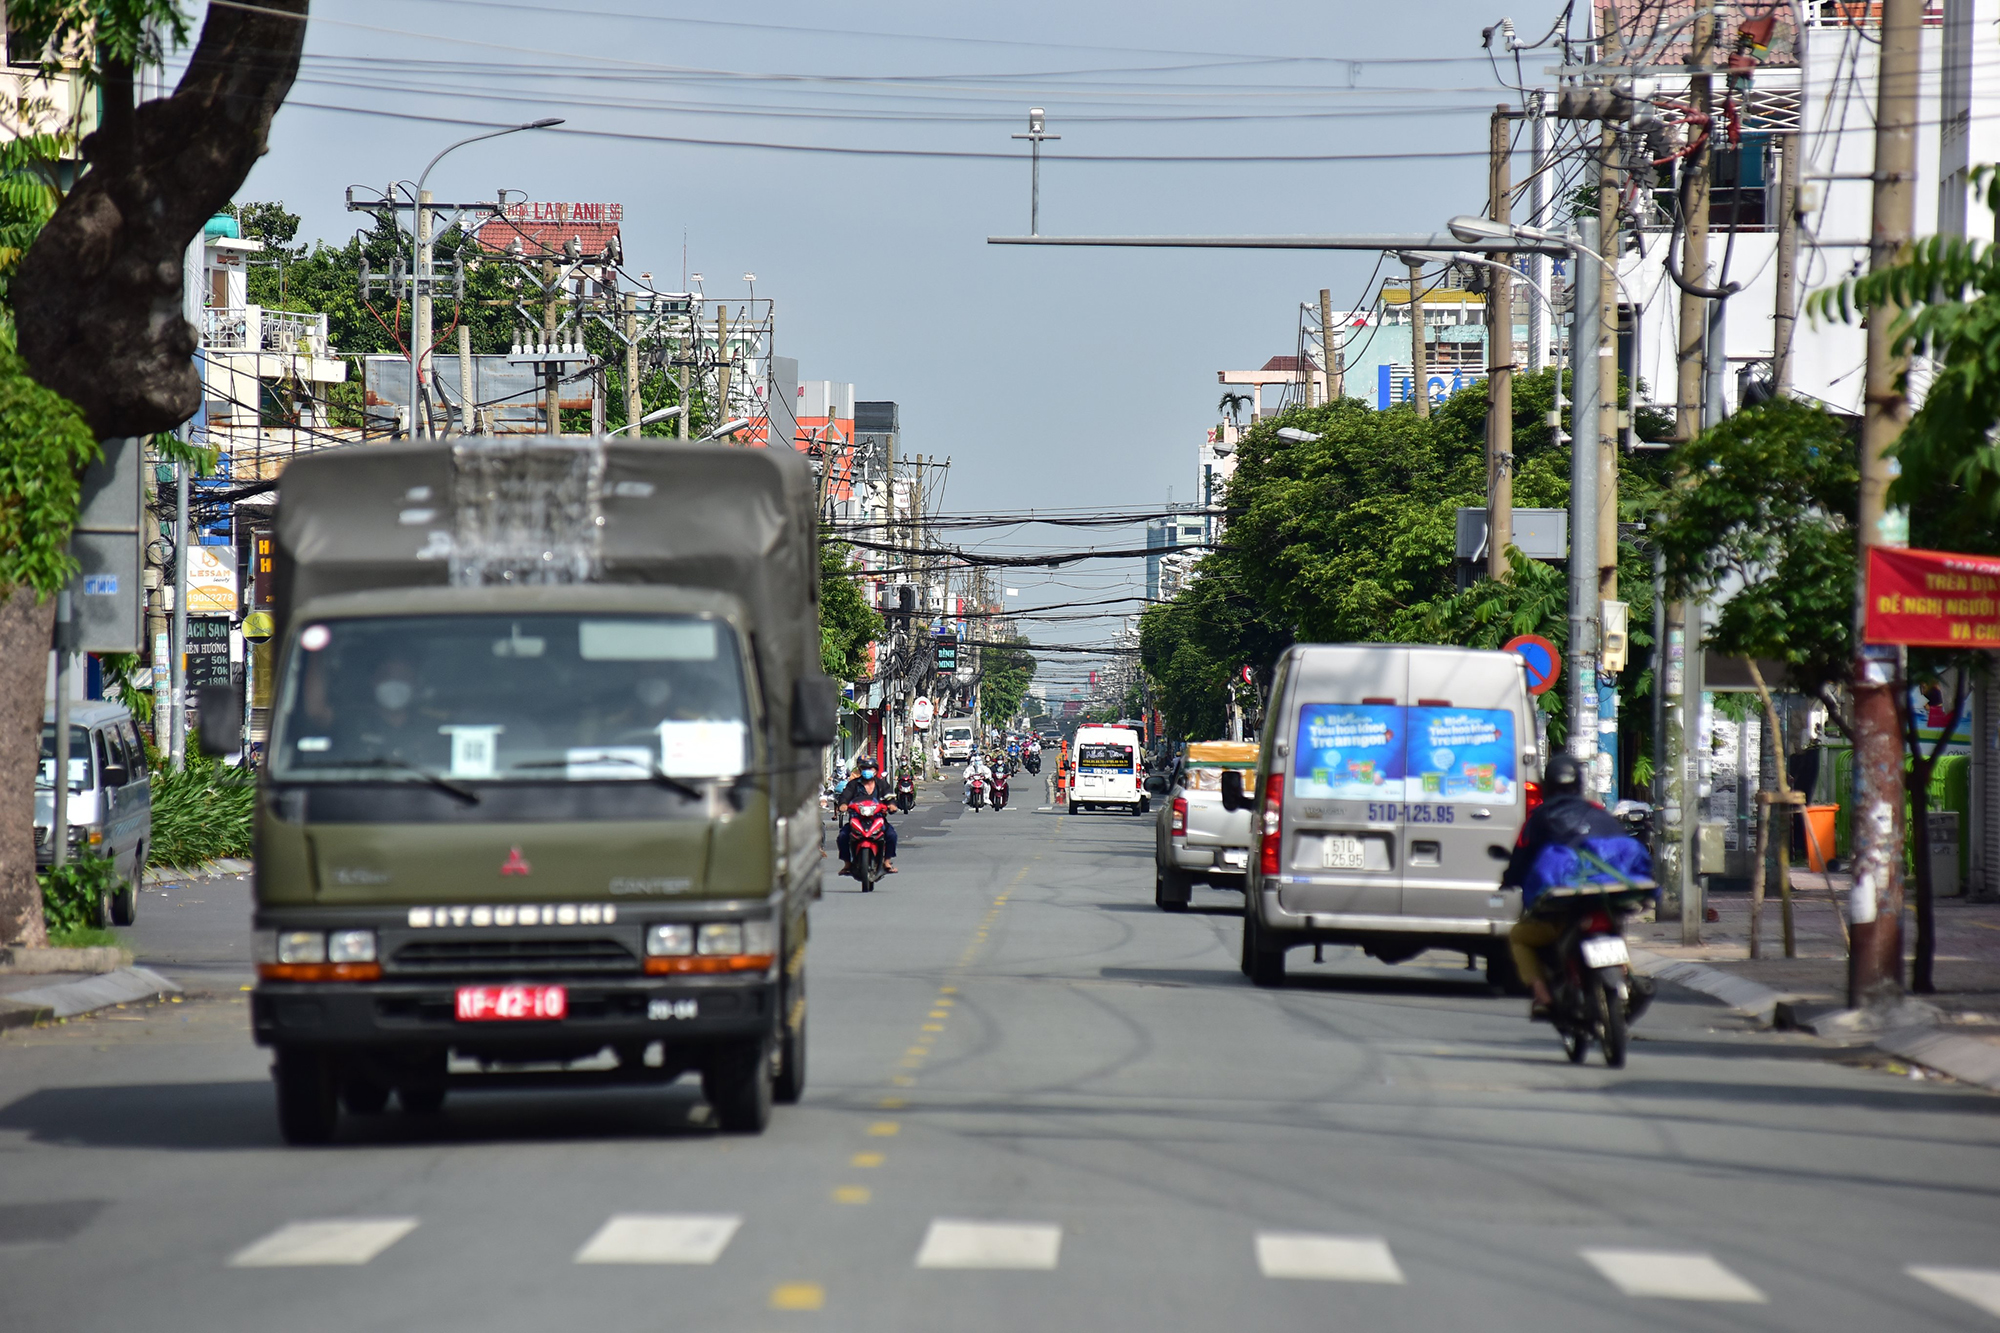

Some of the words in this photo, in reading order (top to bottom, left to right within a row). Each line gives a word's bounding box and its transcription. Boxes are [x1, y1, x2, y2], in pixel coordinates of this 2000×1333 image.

[573, 202, 605, 220] ANH
[1904, 597, 1942, 618] NGHỊ
[187, 620, 206, 638] ÁCH
[208, 623, 227, 640] SẠN
[1951, 620, 1971, 640] VÀ
[185, 642, 199, 654] IÊN
[201, 642, 227, 654] HƯƠNG
[211, 656, 228, 665] 50k
[211, 667, 228, 675] 70k
[208, 678, 228, 686] 180k
[1368, 803, 1455, 824] 51D-125.95
[1332, 840, 1355, 853] 51D
[1324, 853, 1364, 867] 125.95
[407, 904, 617, 928] MITSUBISHI
